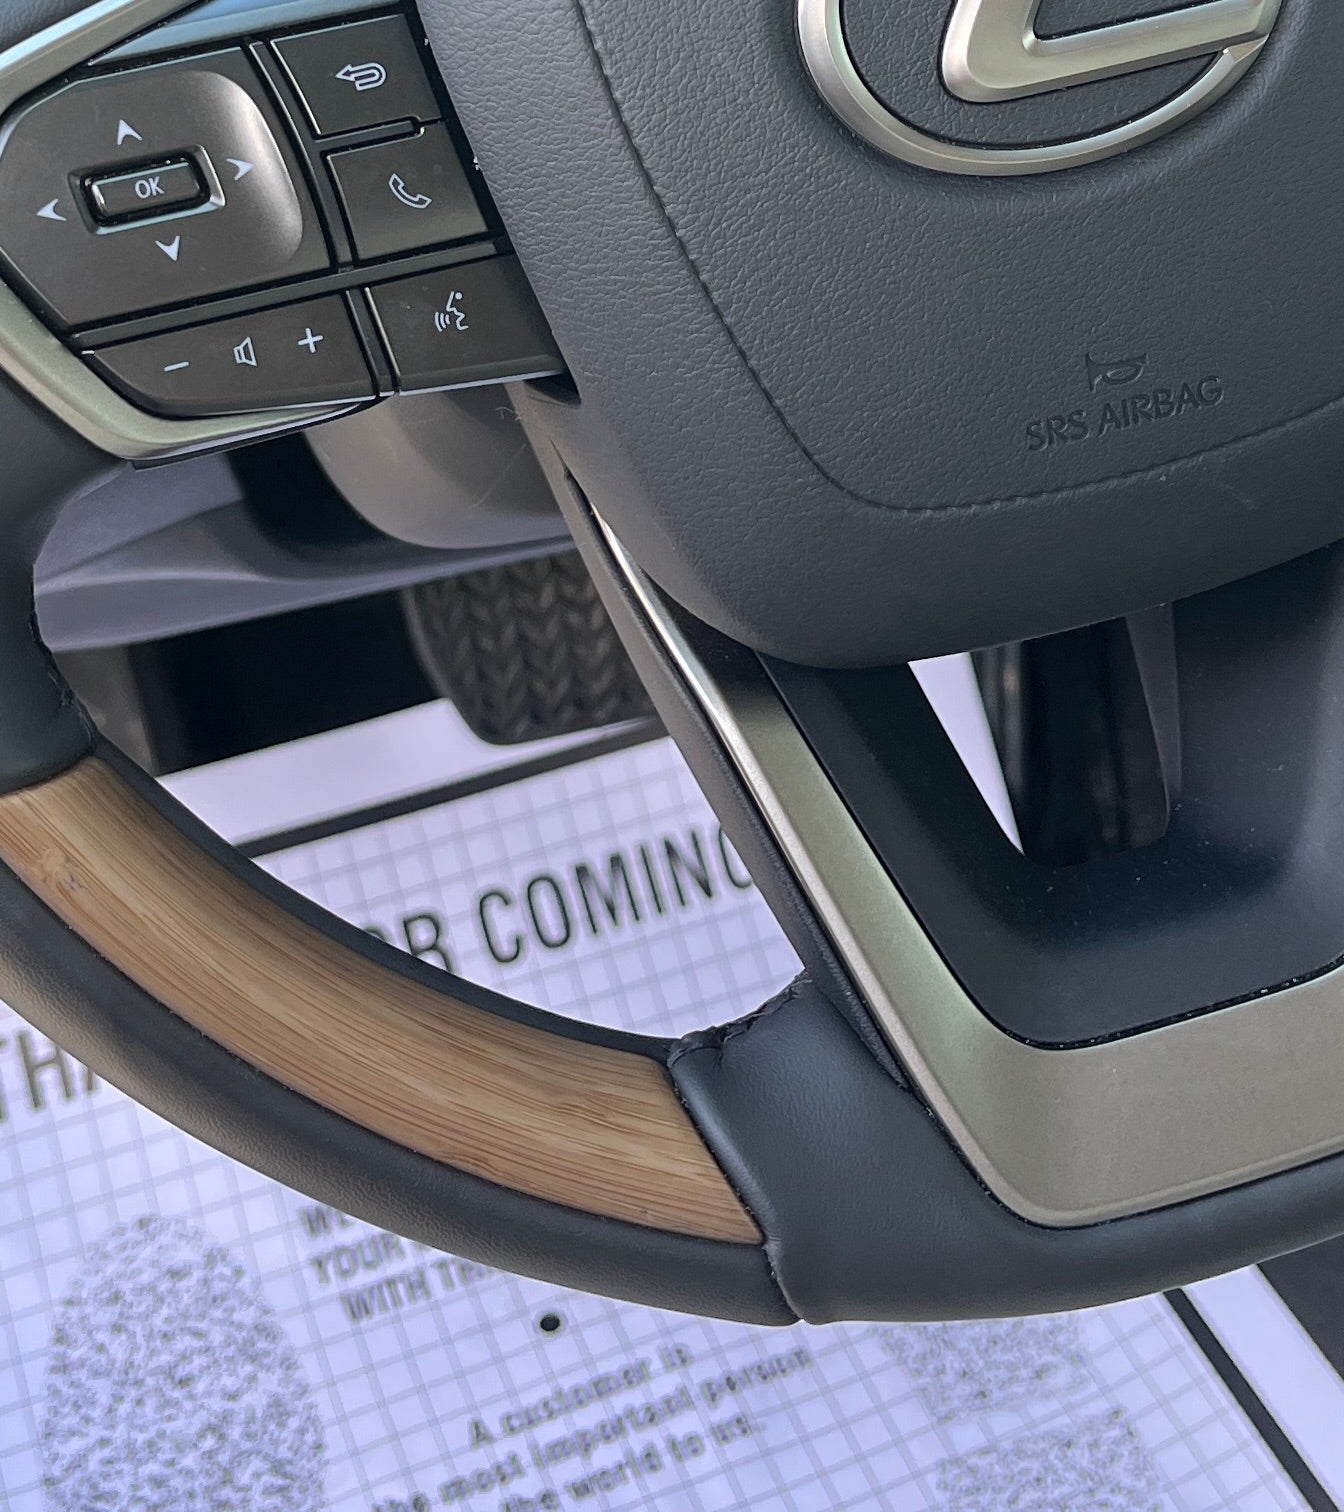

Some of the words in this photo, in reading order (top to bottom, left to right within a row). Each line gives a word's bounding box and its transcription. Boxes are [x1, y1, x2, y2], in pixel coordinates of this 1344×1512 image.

[134, 174, 165, 200] OK
[1025, 408, 1090, 452] SRS
[1097, 374, 1225, 438] AIRBAG
[339, 1266, 432, 1324] WITH
[438, 1452, 526, 1505] most
[531, 1384, 696, 1470] important
[700, 1345, 813, 1408] person
[468, 1416, 494, 1450] A
[499, 1356, 651, 1436] customer
[660, 1342, 694, 1372] is
[564, 1443, 665, 1505] world
[666, 1432, 706, 1465] to
